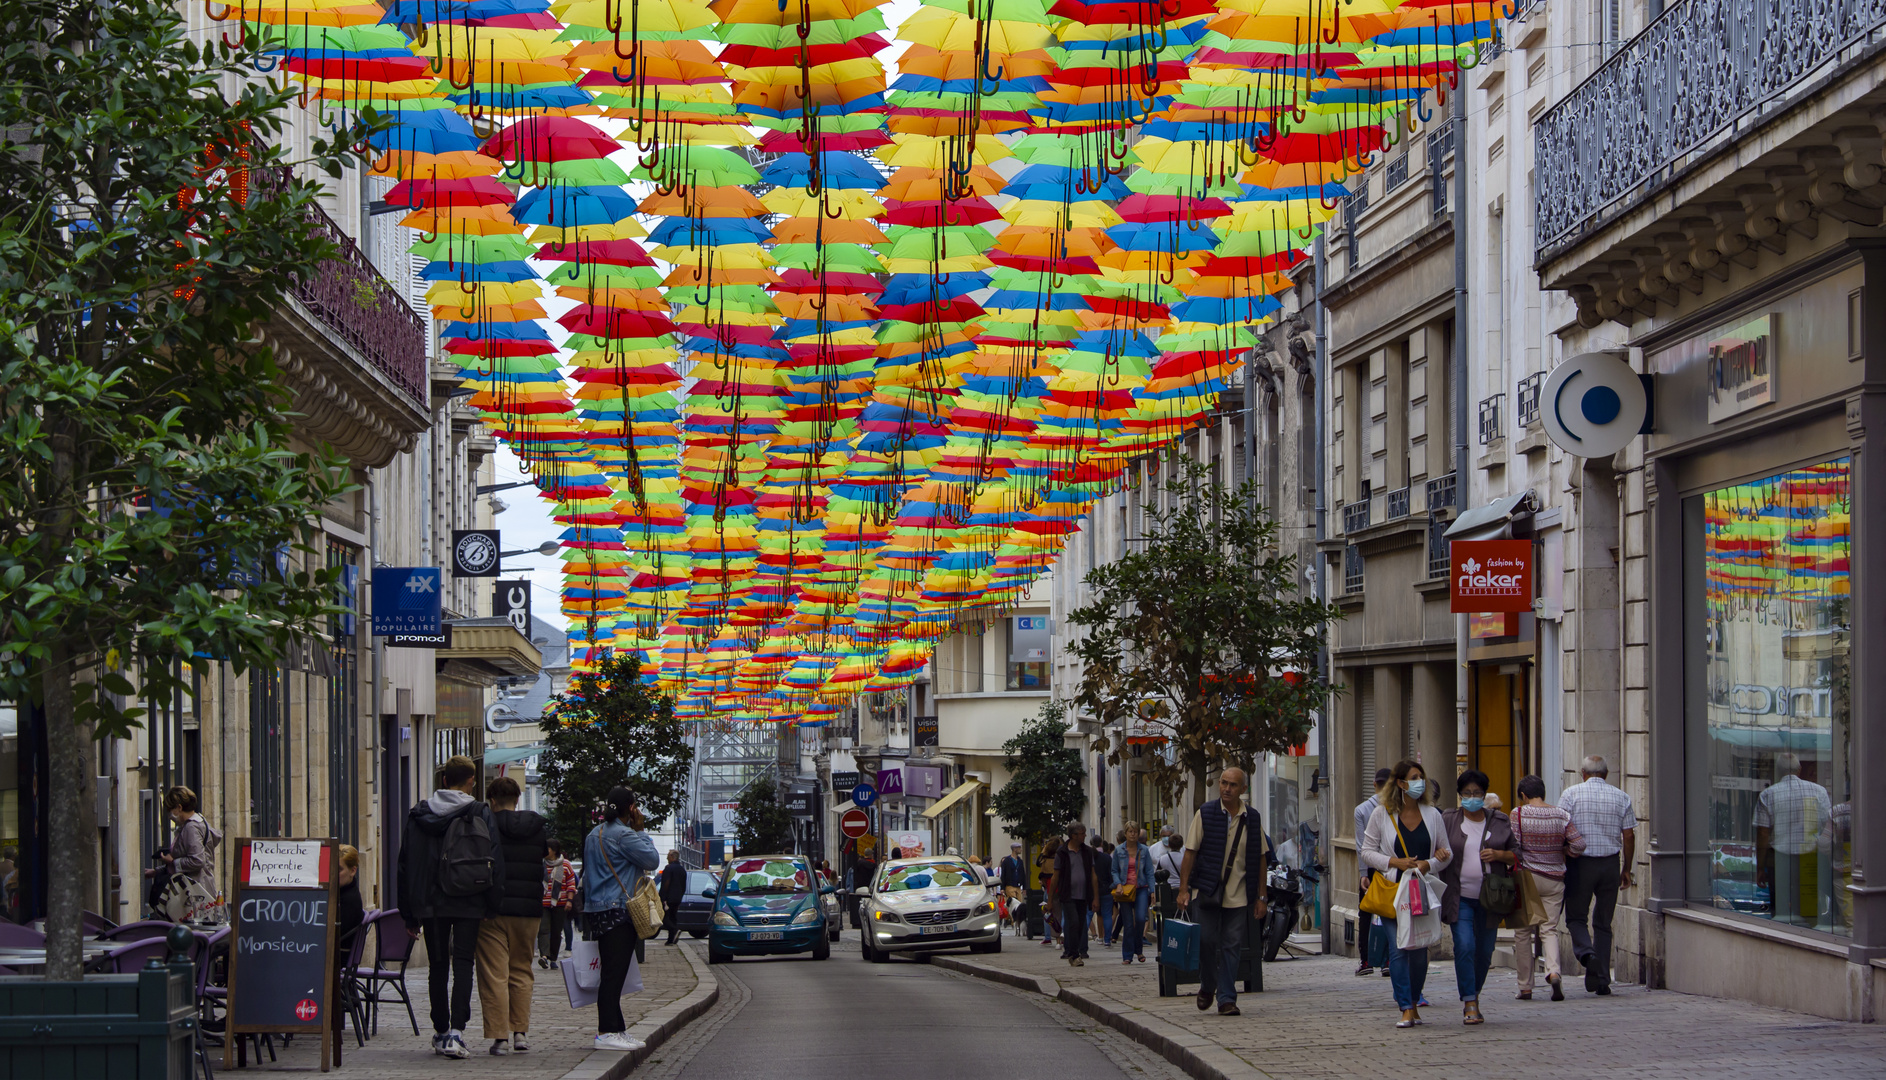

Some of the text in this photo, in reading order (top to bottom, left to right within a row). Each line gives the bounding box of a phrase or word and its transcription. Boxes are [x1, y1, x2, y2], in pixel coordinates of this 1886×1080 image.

[460, 535, 494, 551] BOUCHARA
[1487, 558, 1524, 570] fashion by
[1458, 570, 1522, 587] rieker
[375, 615, 436, 623] BANQUE
[1020, 619, 1043, 628] CIC
[375, 624, 436, 632] POPULAIRE
[395, 635, 446, 643] promod
[917, 726, 937, 734] plus
[253, 841, 308, 855] Recherche
[251, 858, 303, 873] Apprentie
[240, 899, 327, 927] CROQUE
[237, 936, 319, 954] Monsieur
